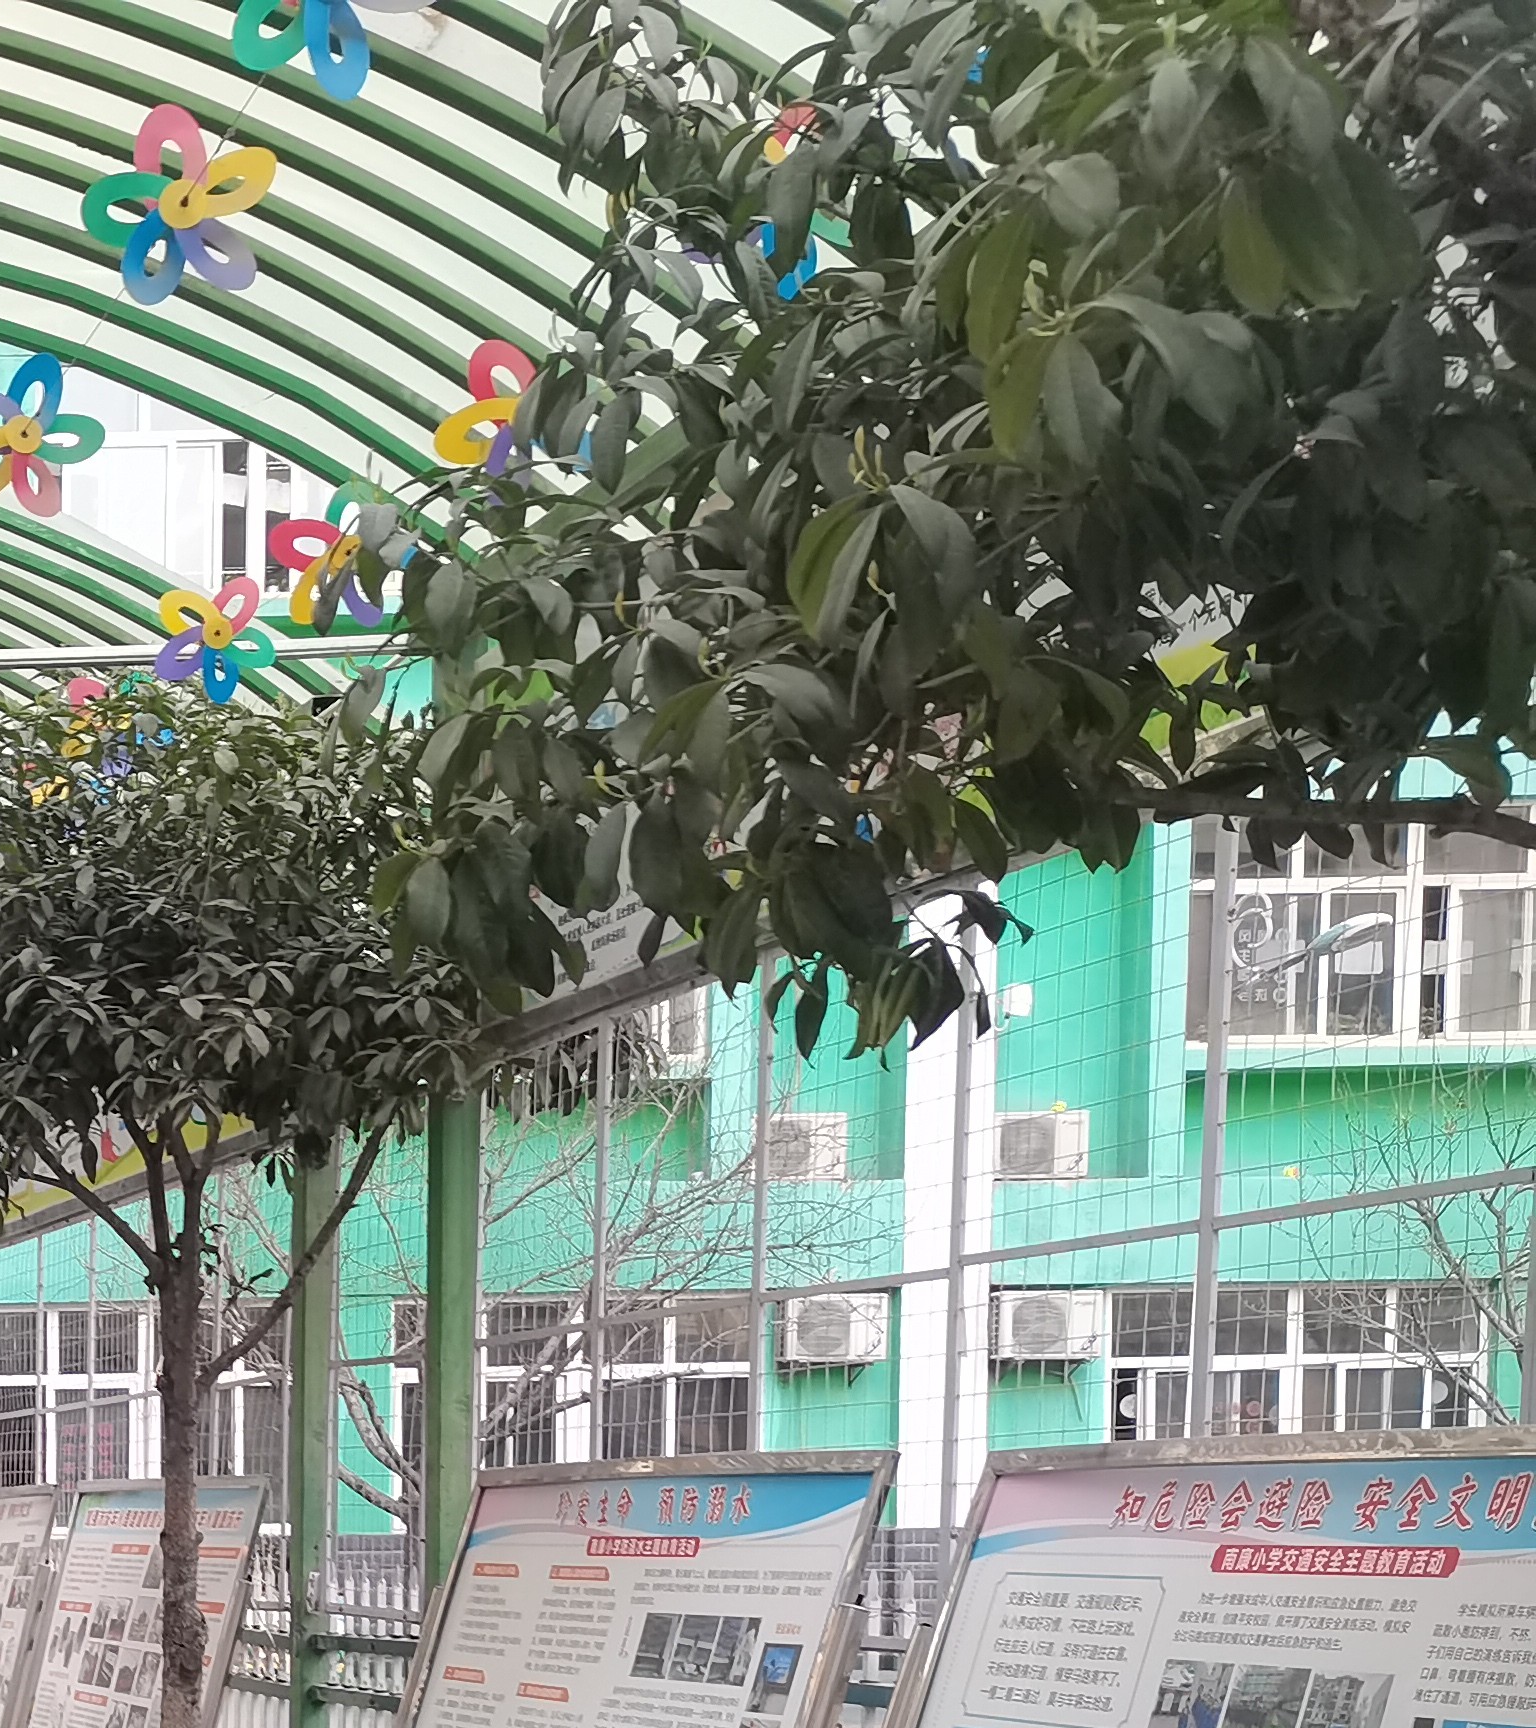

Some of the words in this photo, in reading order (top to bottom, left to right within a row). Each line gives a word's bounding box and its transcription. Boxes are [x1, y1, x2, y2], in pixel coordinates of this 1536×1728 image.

[1109, 1477, 1331, 1532] 知危险会避险
[1354, 1470, 1536, 1533] 安全文明
